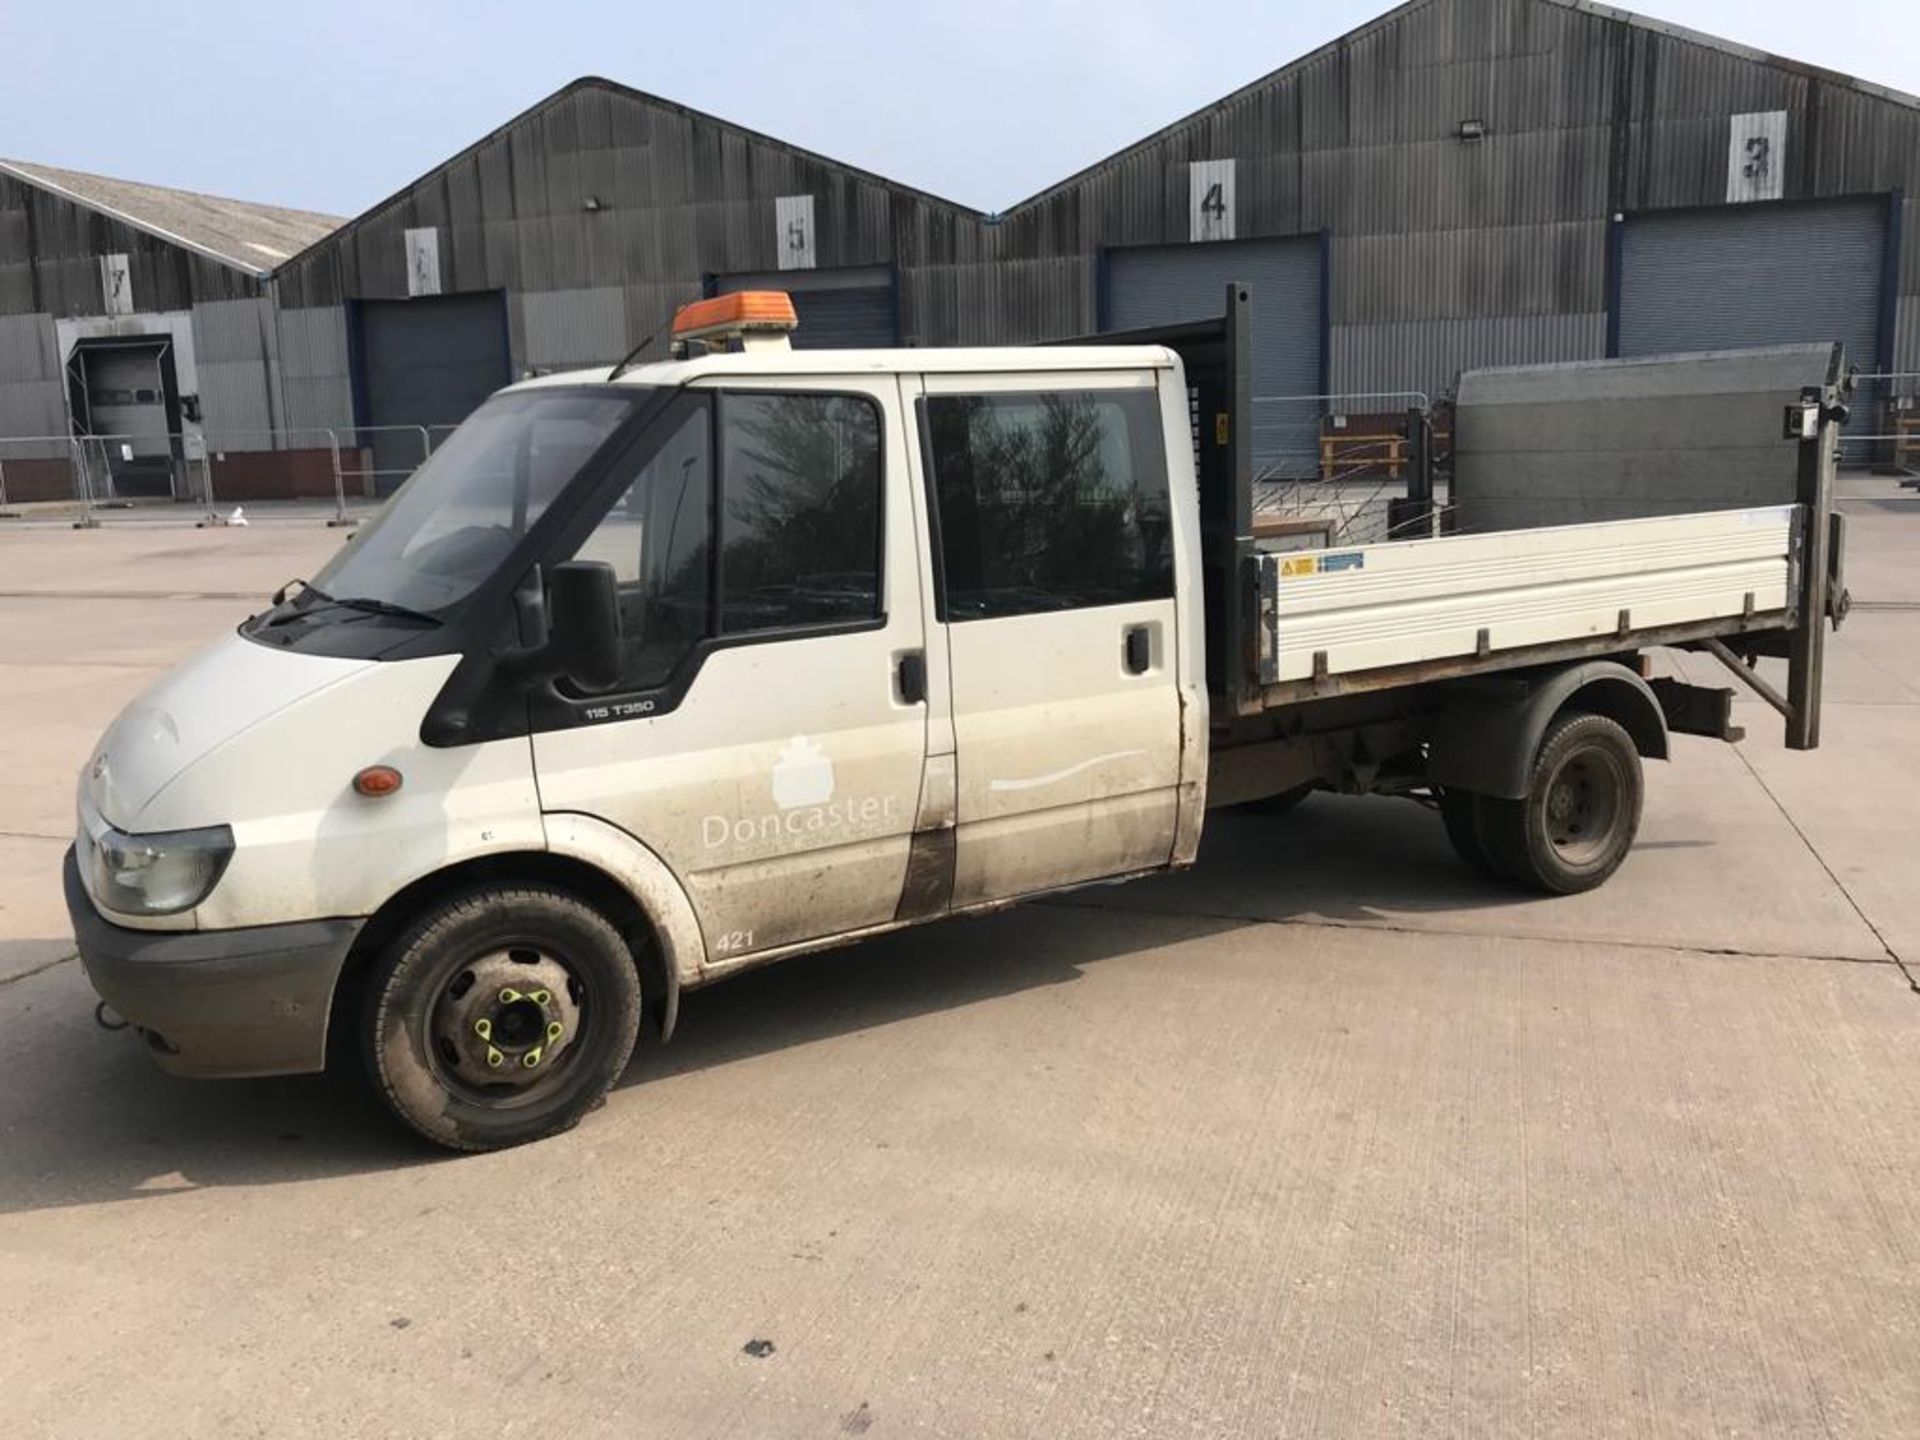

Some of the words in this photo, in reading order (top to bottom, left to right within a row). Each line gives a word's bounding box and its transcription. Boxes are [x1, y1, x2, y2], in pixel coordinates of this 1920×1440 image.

[1743, 137, 1769, 178] 3
[1201, 183, 1225, 220] 4
[586, 707, 608, 719] 115
[612, 700, 655, 715] T350
[702, 795, 895, 848] Doncaster
[716, 930, 752, 951] 421
